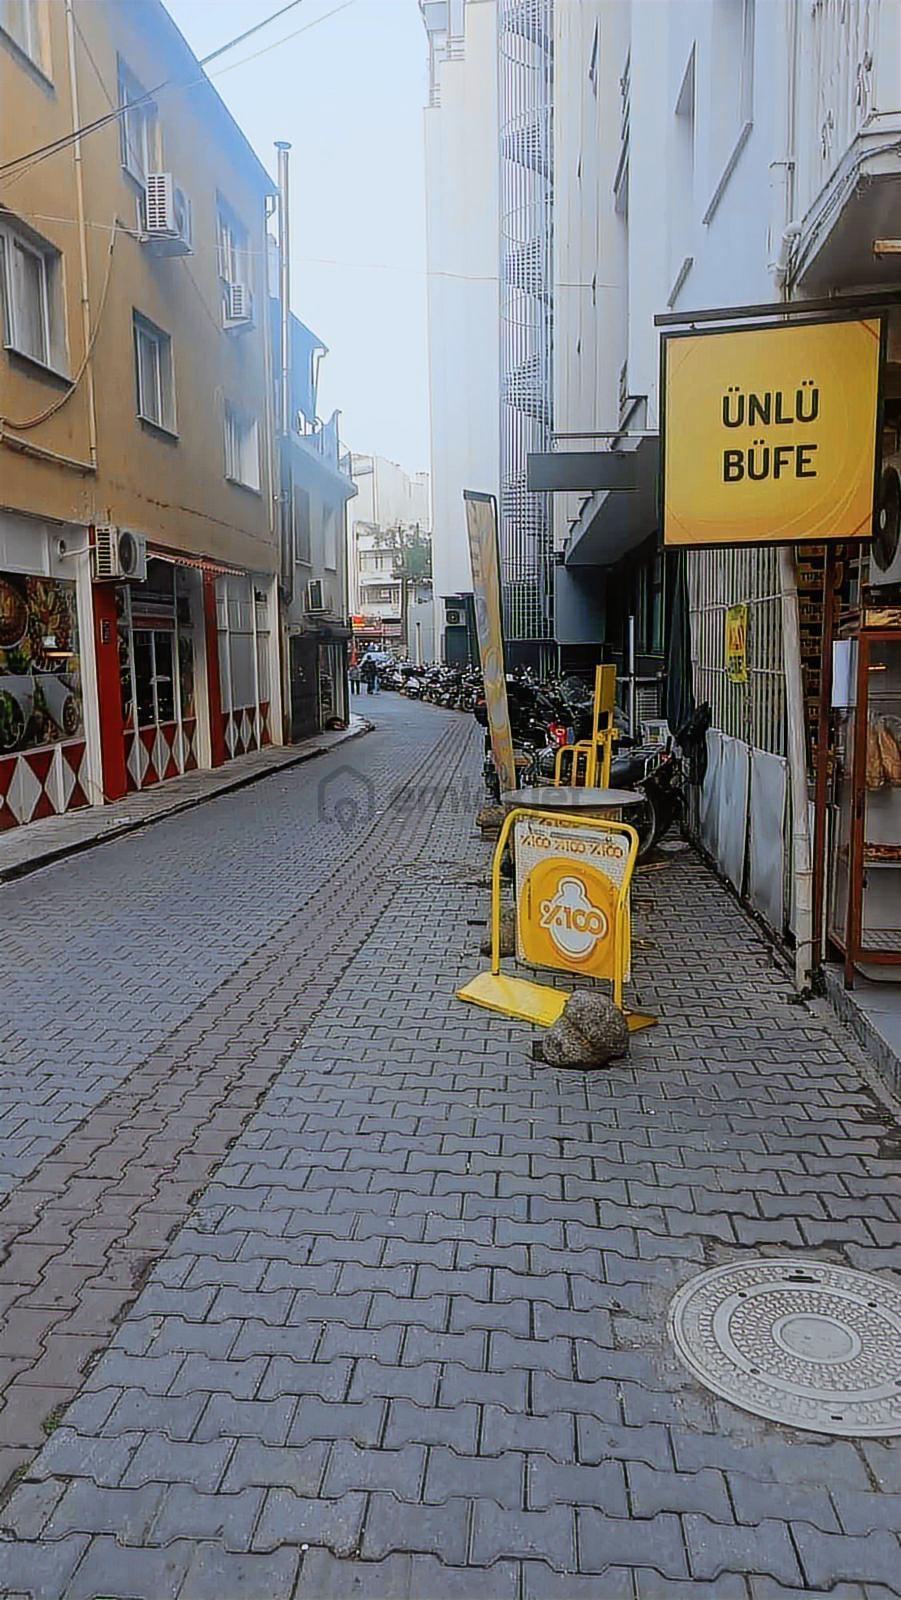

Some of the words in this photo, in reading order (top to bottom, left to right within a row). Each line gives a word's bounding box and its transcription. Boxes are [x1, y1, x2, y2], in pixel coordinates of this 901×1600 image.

[722, 380, 819, 428] ÜNLÜ
[723, 439, 818, 482] BÜFE
[543, 904, 604, 934] %100
